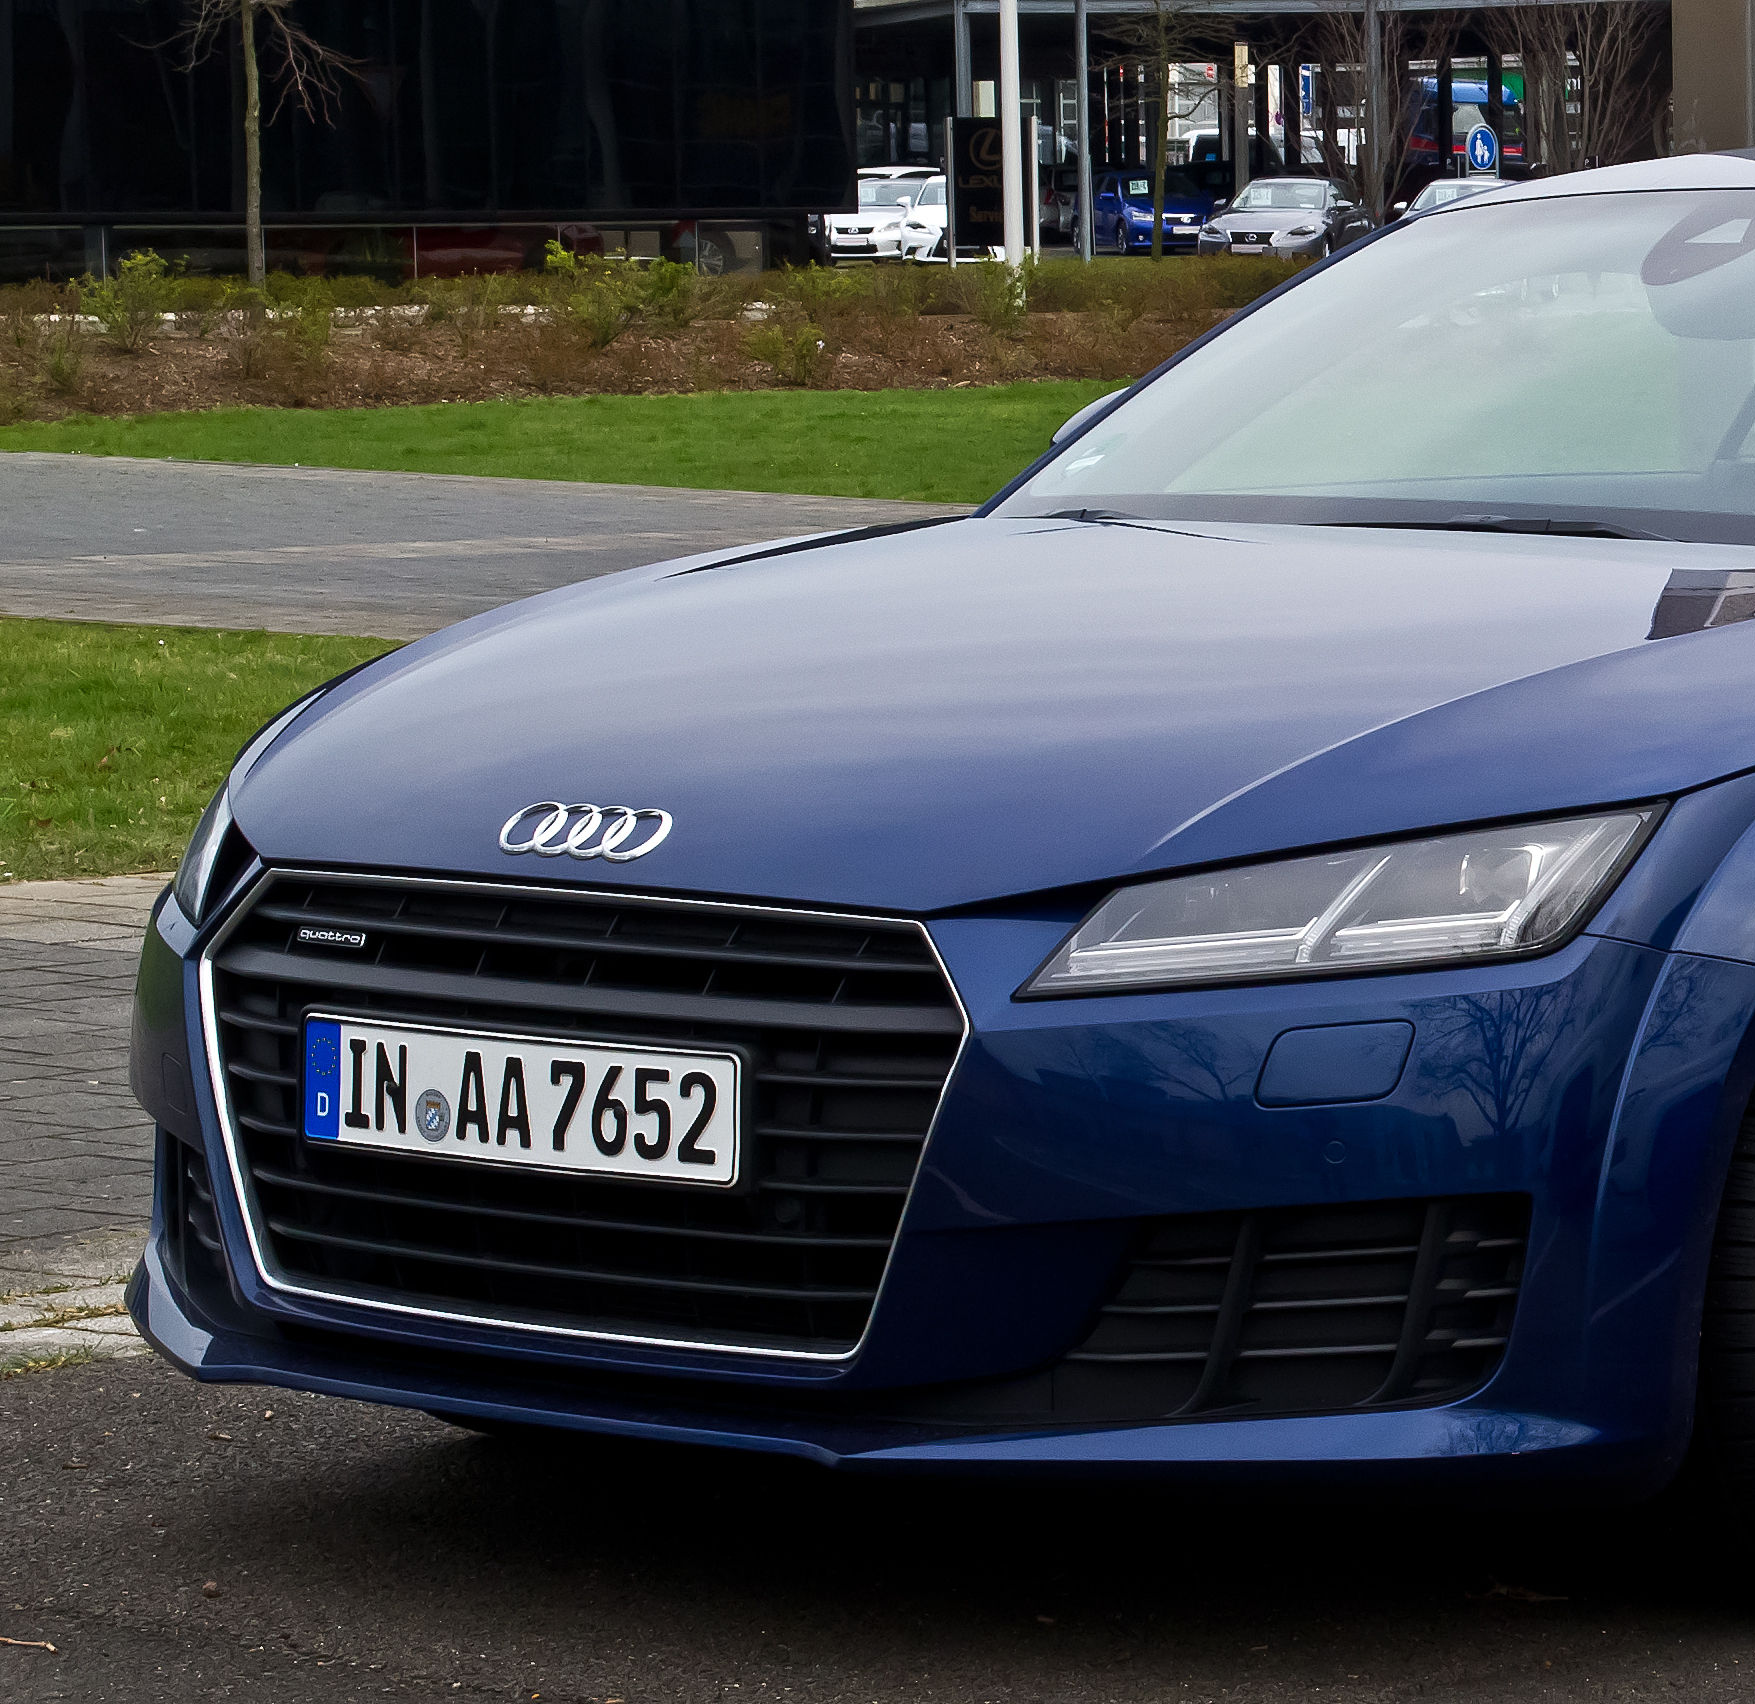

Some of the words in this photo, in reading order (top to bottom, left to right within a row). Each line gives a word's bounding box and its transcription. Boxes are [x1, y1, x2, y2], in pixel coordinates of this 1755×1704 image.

[300, 929, 361, 944] quattro
[316, 1091, 330, 1117] D
[344, 1037, 407, 1135] IN
[455, 1050, 532, 1149] AA
[550, 1059, 719, 1166] 7652
